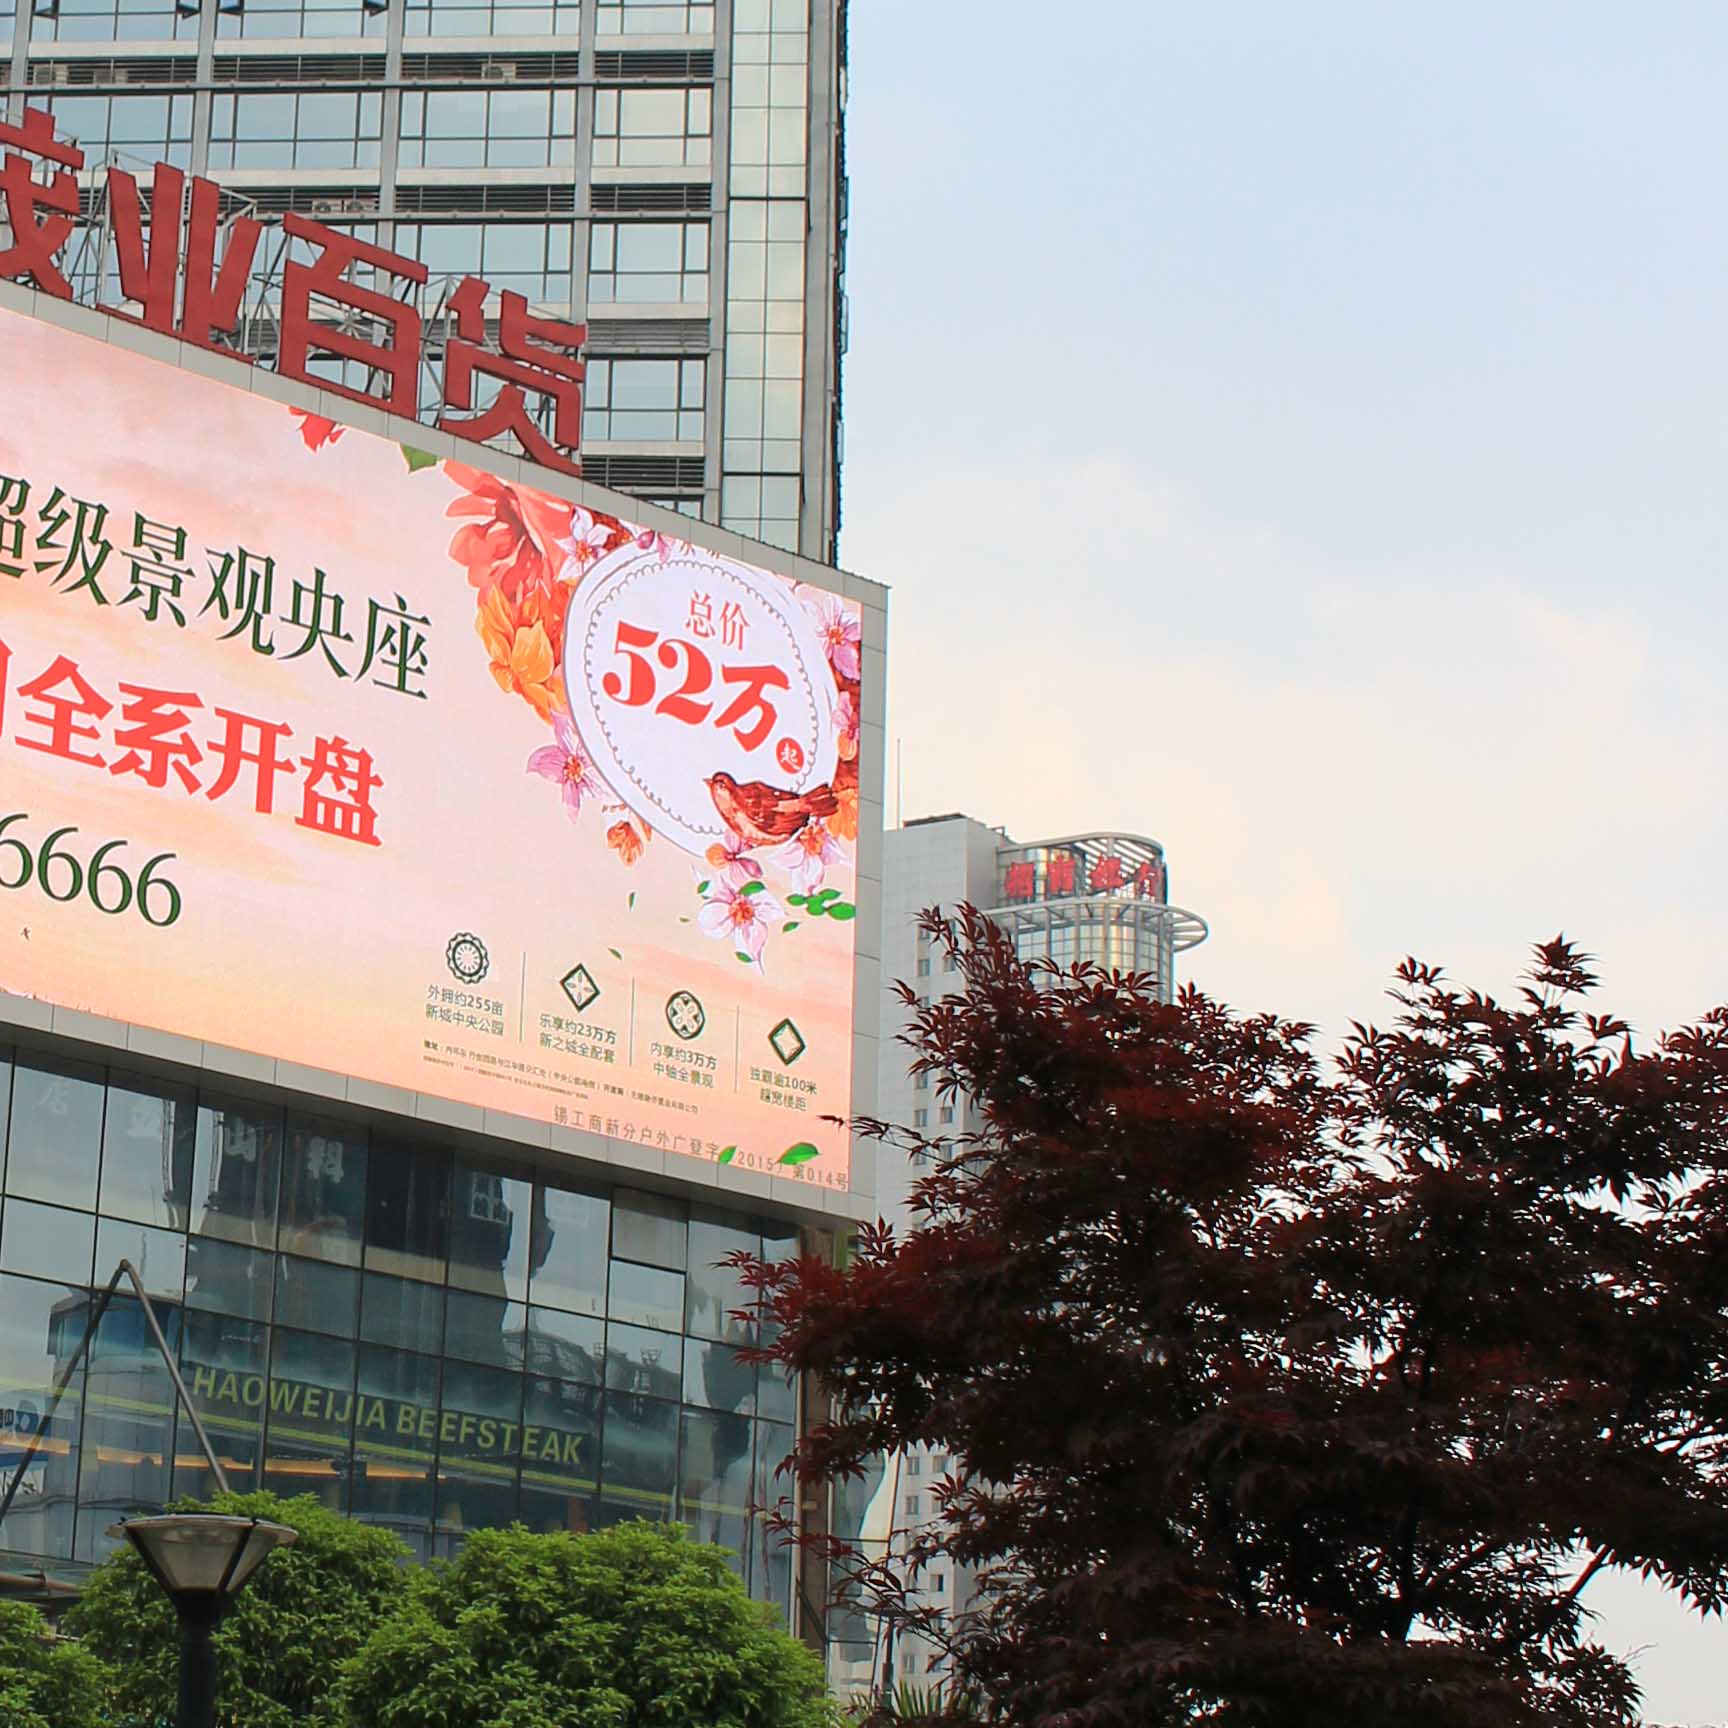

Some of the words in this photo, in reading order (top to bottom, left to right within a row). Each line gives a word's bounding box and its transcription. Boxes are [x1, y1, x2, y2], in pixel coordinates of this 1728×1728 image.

[685, 590, 750, 651] 总价
[425, 1003, 504, 1036] 新城中央公园
[192, 1367, 387, 1430] HAOWEIJIA
[396, 1405, 585, 1465] BEEFSTEAK
